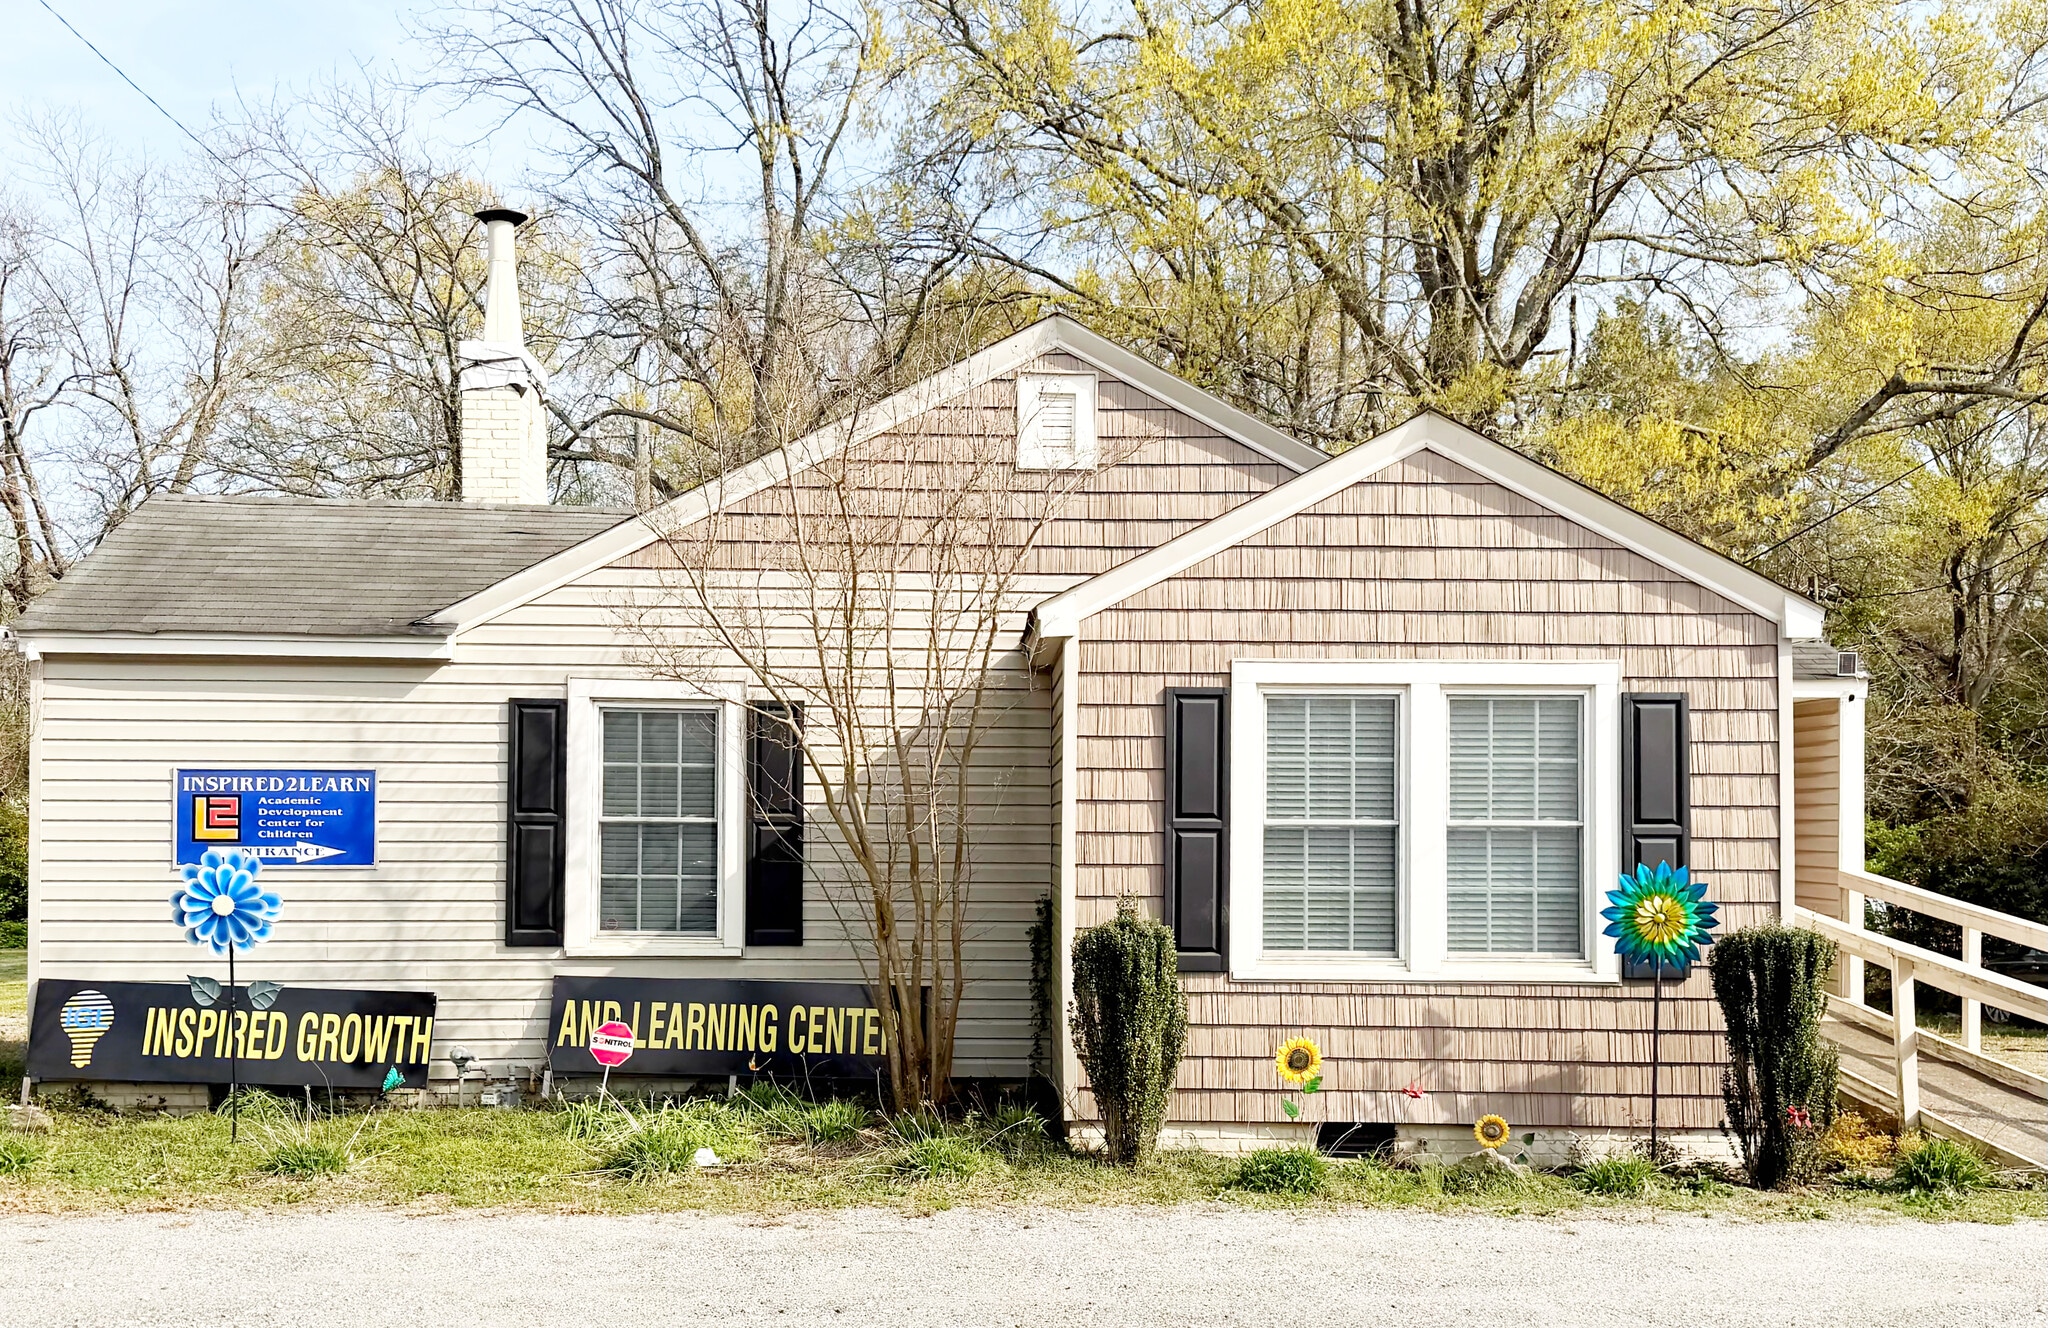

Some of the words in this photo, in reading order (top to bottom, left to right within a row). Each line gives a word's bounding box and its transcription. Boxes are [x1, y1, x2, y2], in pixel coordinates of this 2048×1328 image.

[182, 776, 371, 792] INSPIRED2LEARN
[258, 797, 322, 805] Academic
[258, 808, 344, 817] Development
[258, 819, 302, 827] Center
[305, 819, 325, 827] for
[258, 830, 314, 838] Children
[236, 847, 326, 857] NTRANCE
[65, 1006, 110, 1029] IGL
[631, 1001, 779, 1053] LEARNING
[141, 1007, 289, 1060] INSPIRED
[296, 1012, 433, 1066] GROWTH
[592, 1036, 632, 1048] SONITROL
